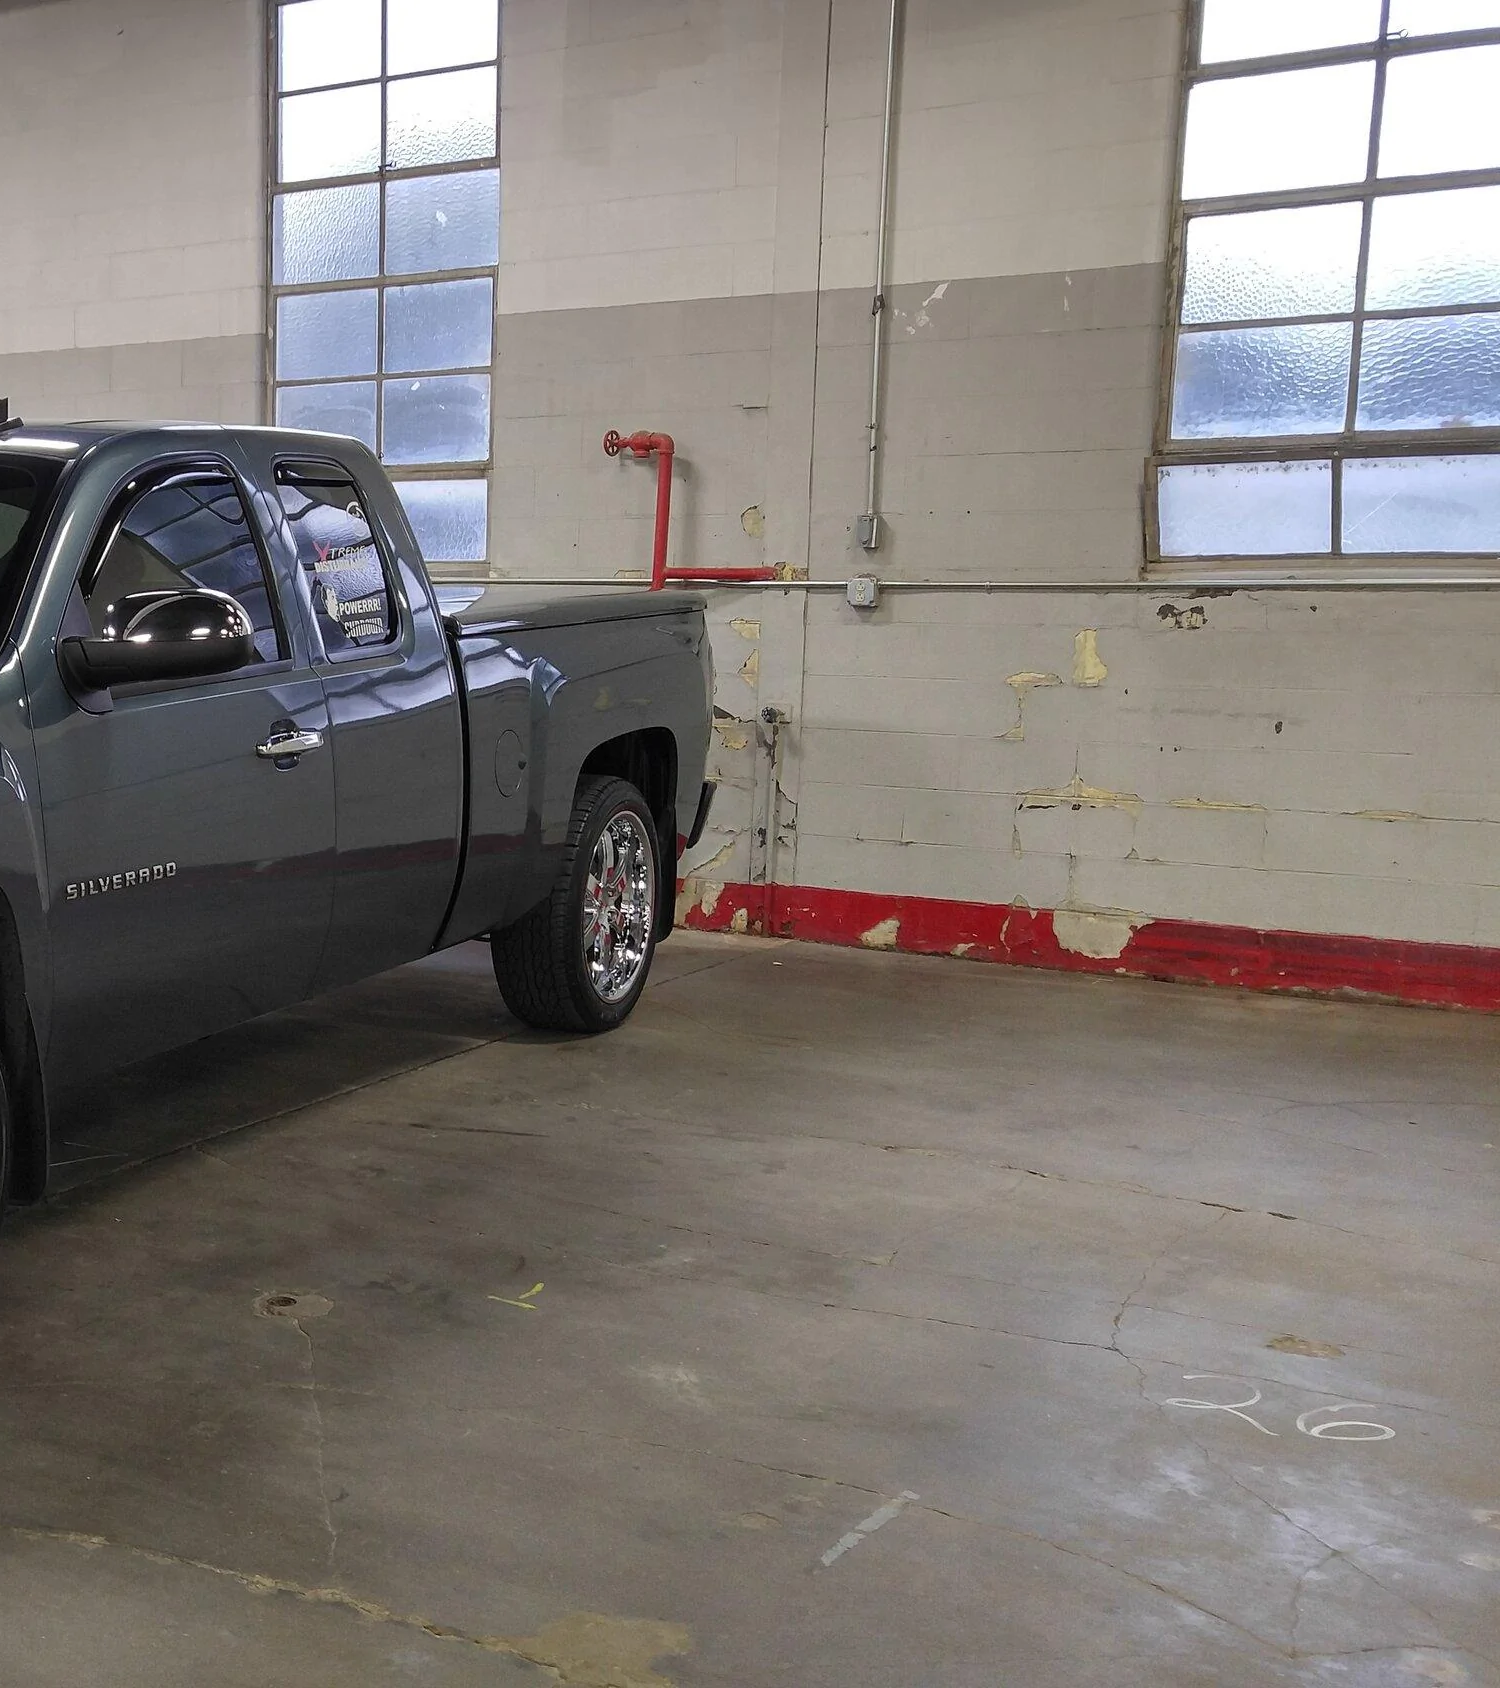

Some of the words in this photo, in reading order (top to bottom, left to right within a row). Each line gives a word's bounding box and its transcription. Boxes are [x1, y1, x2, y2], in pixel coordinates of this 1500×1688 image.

[339, 598, 382, 616] POWERRR!
[66, 861, 178, 900] SILVERADO
[1165, 1374, 1396, 1441] 26
